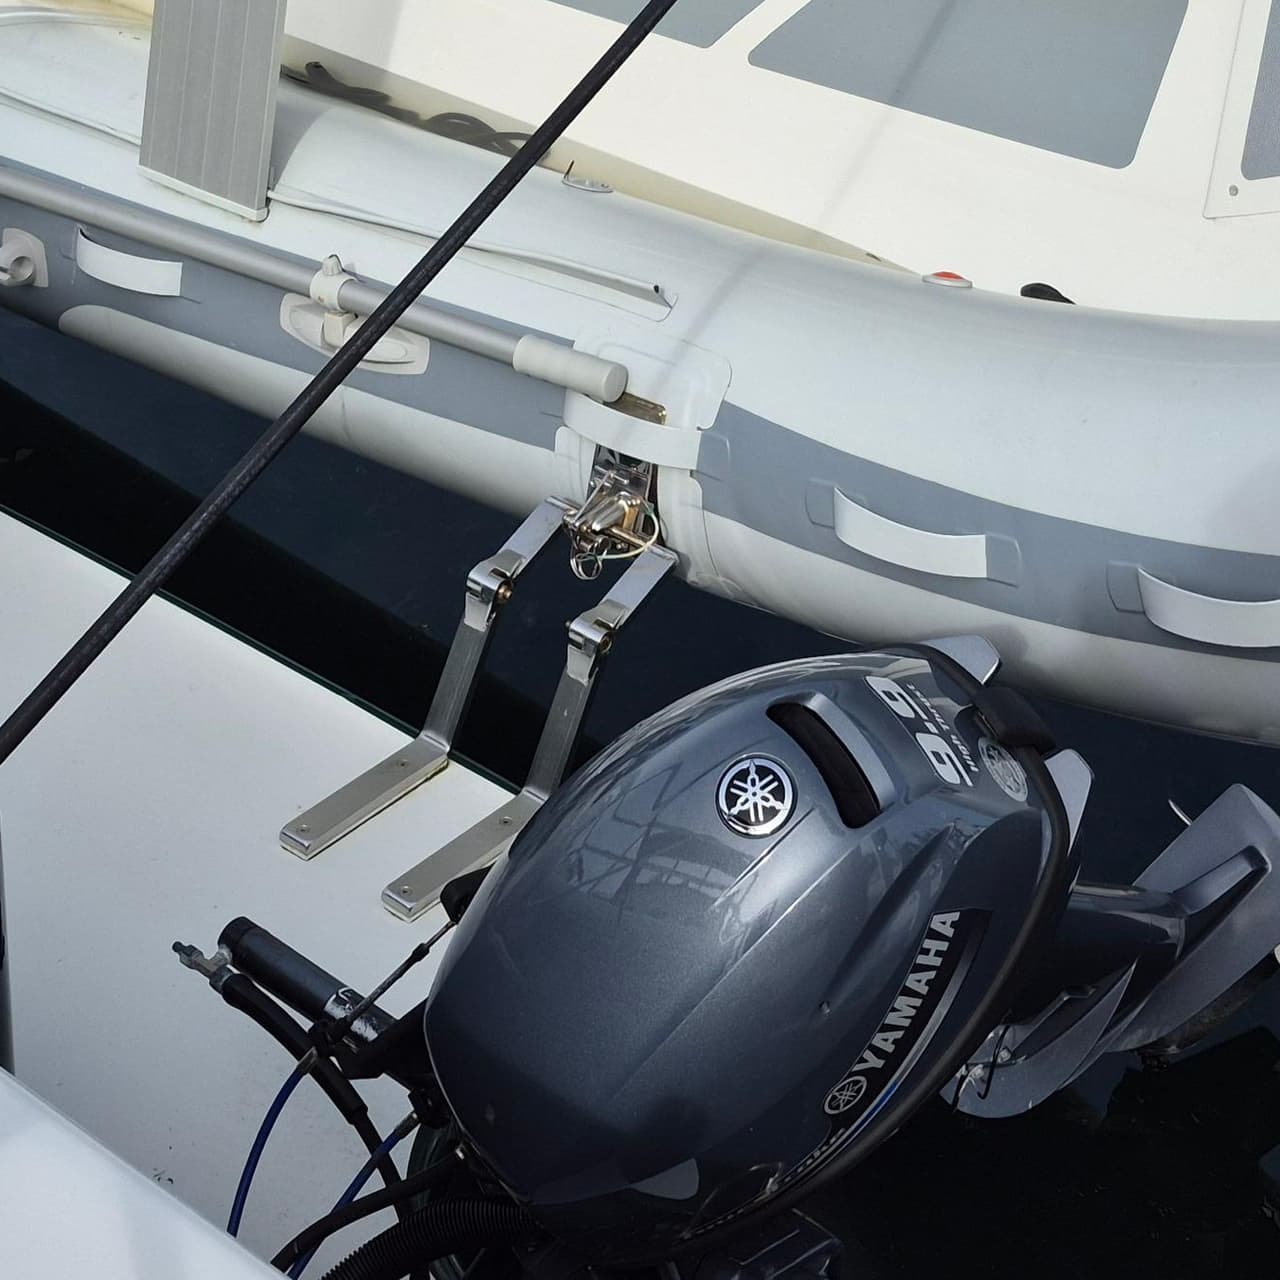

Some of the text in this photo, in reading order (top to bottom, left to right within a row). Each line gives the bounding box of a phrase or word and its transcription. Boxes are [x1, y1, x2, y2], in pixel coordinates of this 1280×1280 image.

[865, 676, 973, 787] 9.9
[906, 683, 979, 772] High Thrust
[852, 911, 960, 1072] YAMAHA
